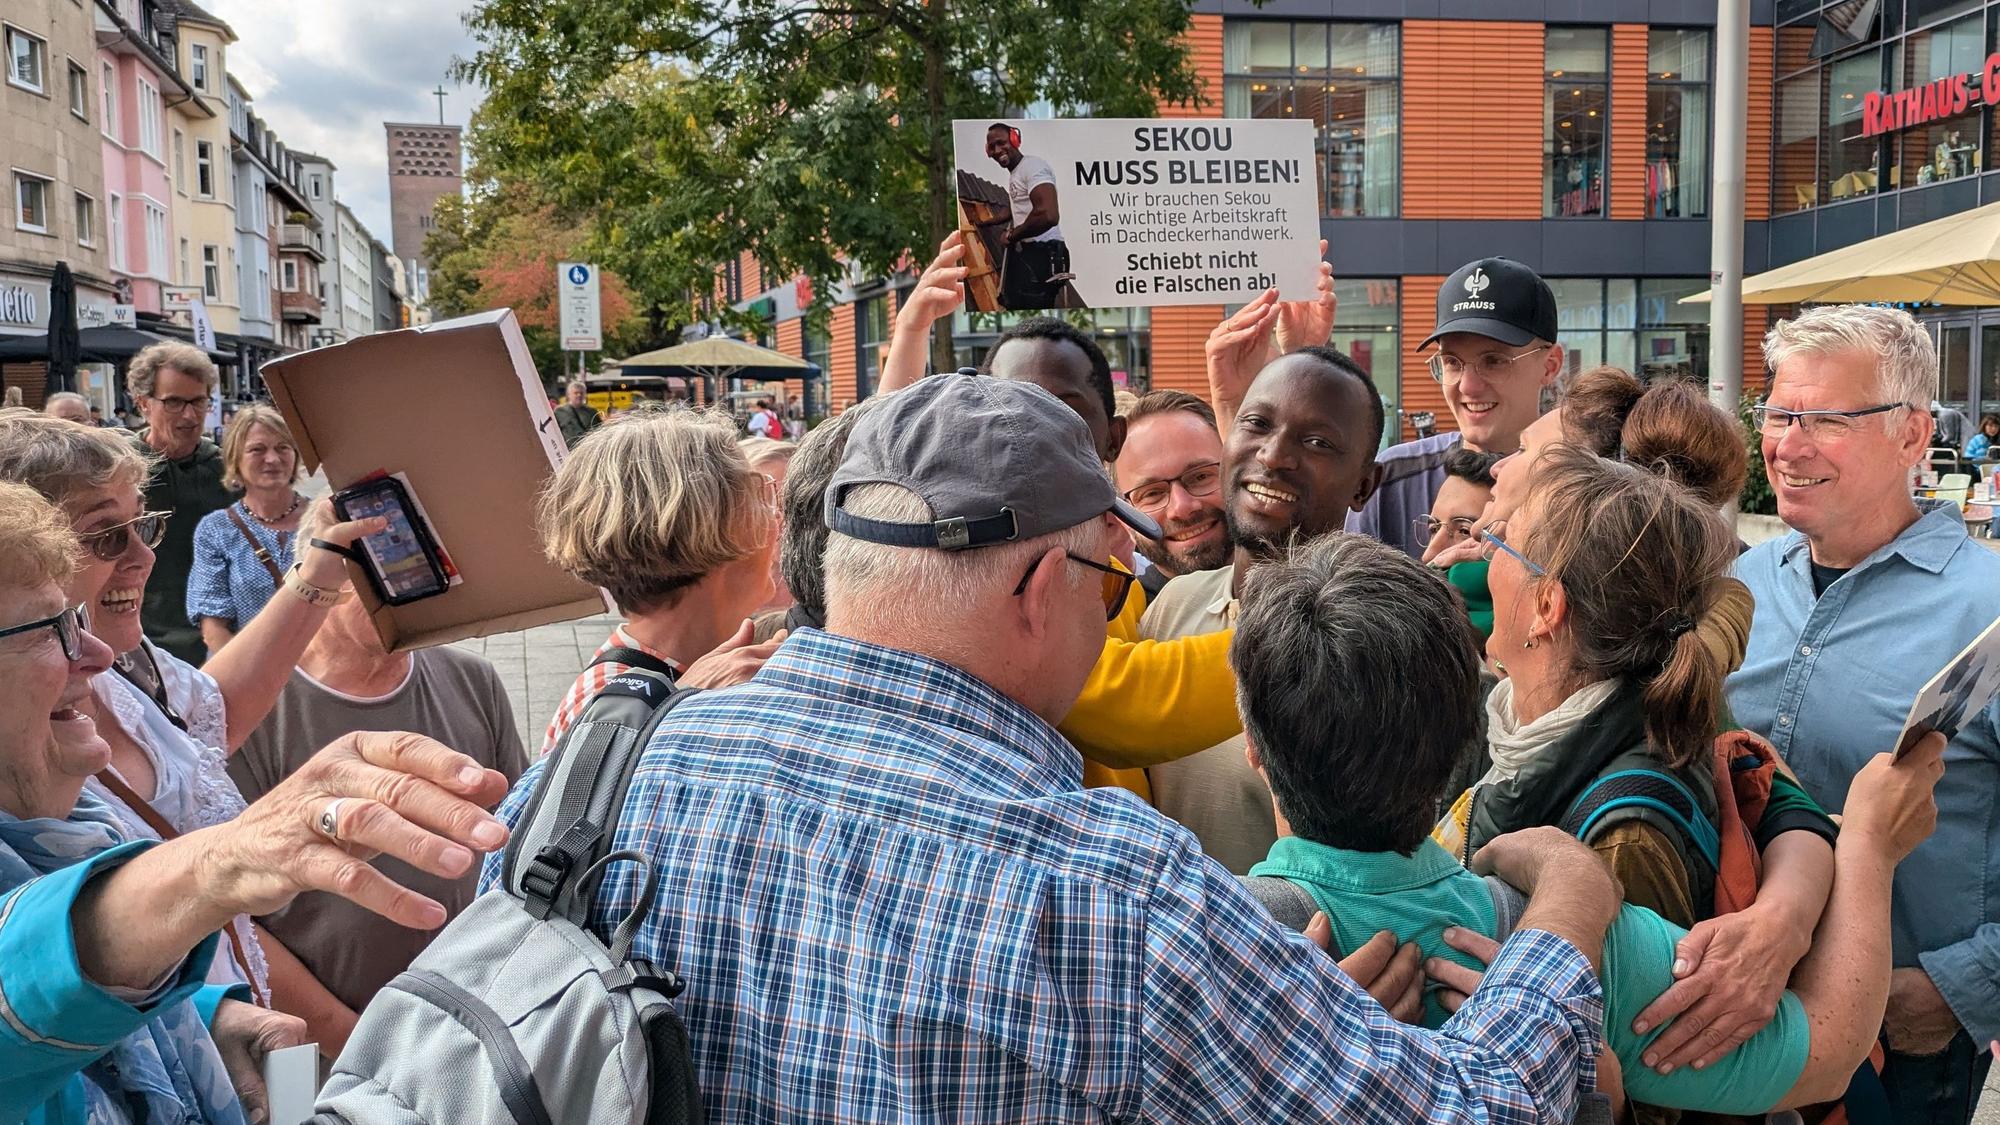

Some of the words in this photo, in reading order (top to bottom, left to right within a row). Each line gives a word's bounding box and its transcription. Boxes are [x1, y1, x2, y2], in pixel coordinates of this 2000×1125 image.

[1135, 127, 1232, 151] SEKOU
[1075, 160, 1158, 185] MUSS
[1169, 160, 1299, 184] BLEIBEN!
[1110, 192, 1138, 207] Wir
[1145, 192, 1218, 206] brauchen
[1225, 191, 1270, 205] Sekou
[1090, 211, 1112, 225] als
[1118, 210, 1187, 227] wichtige
[1193, 208, 1287, 223] Arbeitskraft
[1091, 229, 1110, 243] im
[1117, 226, 1293, 243] Dachdeckerhandwerk.
[1127, 252, 1202, 271] Schiebt
[1209, 251, 1258, 268] nicht
[1116, 276, 1147, 294] die
[1154, 274, 1240, 293] Falschen
[1248, 273, 1276, 290] ab!
[1453, 301, 1495, 312] STRAUSS
